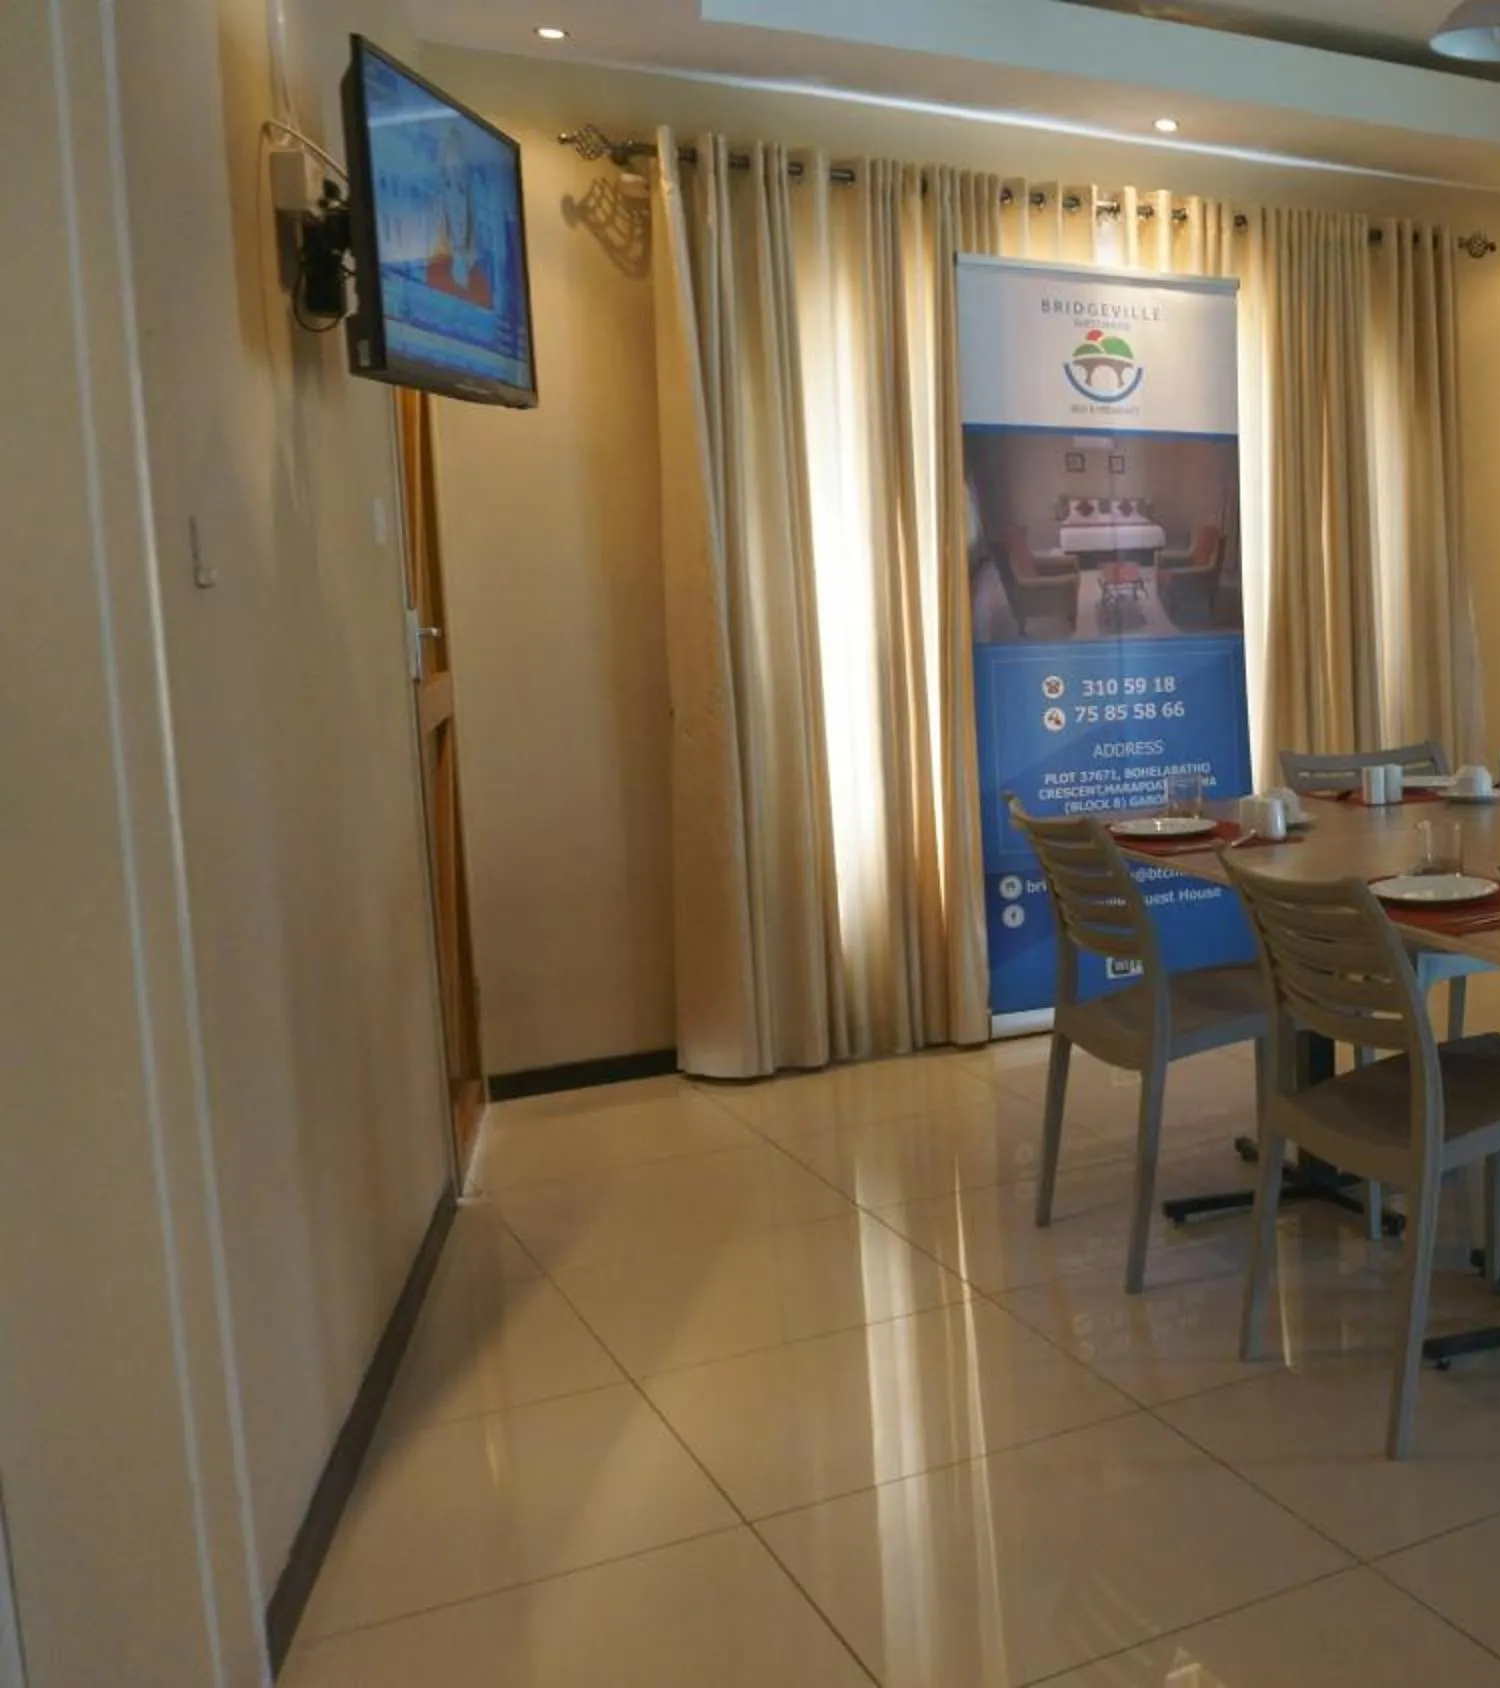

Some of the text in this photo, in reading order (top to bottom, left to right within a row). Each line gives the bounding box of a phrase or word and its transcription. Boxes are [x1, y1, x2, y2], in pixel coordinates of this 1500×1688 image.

[1040, 298, 1162, 321] BRIDGEVILLE
[1082, 675, 1177, 697] 310 59 18
[1075, 701, 1185, 723] 75 85 58 66
[1093, 739, 1165, 759] ADDRESS
[1044, 771, 1076, 785] PLOT
